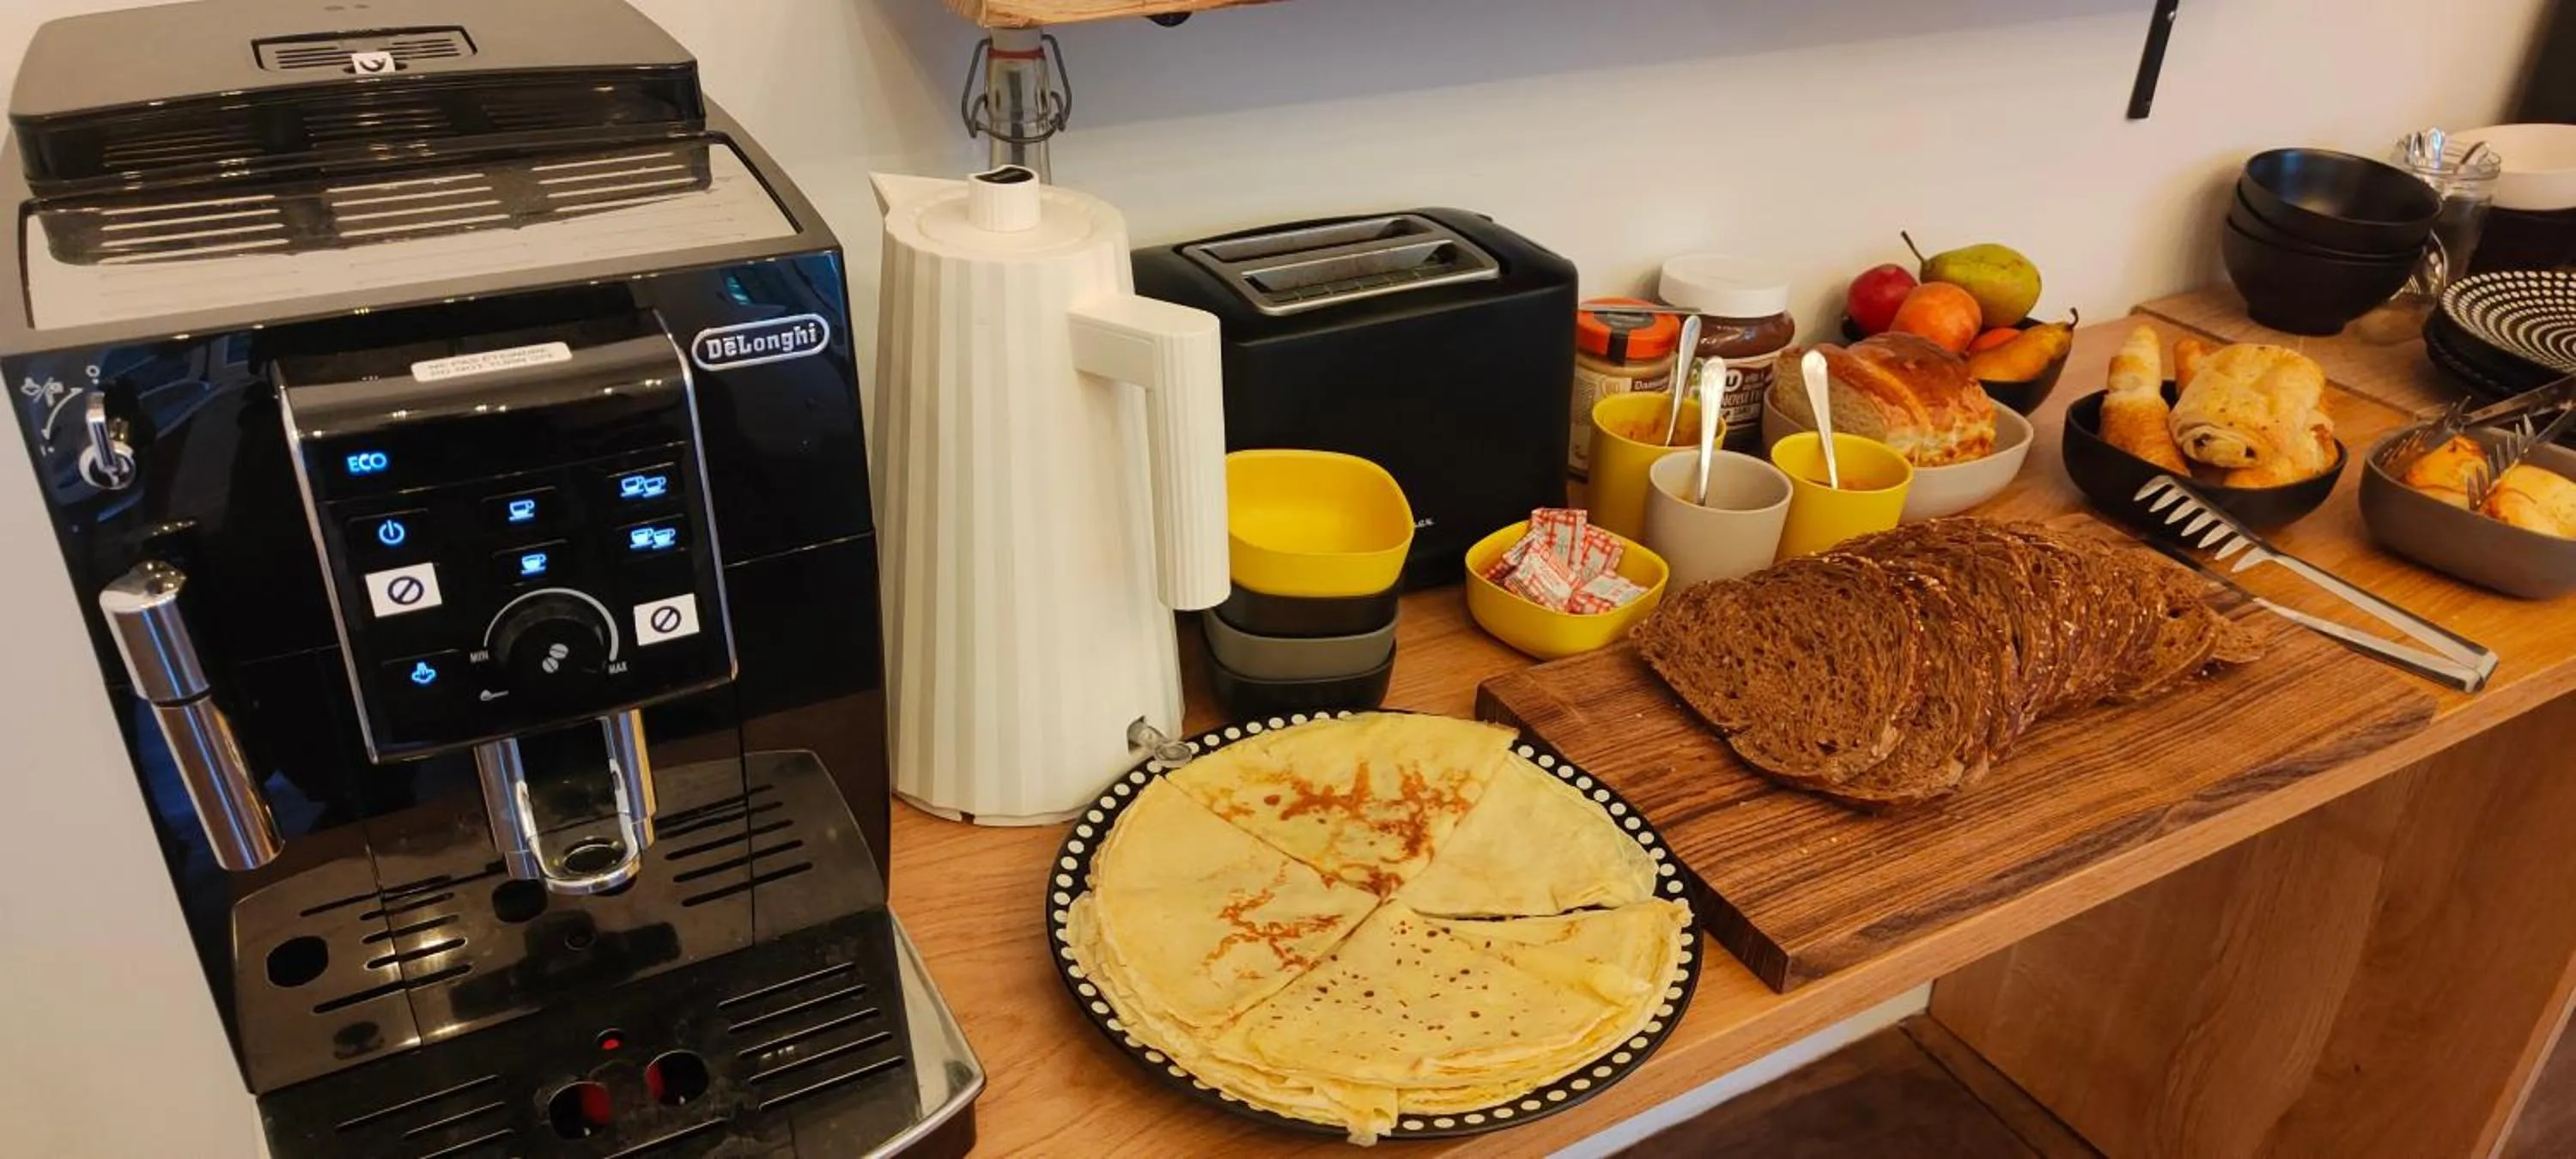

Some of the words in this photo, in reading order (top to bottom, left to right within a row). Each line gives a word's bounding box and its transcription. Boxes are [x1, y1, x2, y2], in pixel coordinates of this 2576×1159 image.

[346, 452, 388, 473] ECO
[470, 650, 489, 664] MIN
[608, 660, 629, 675] MAX
